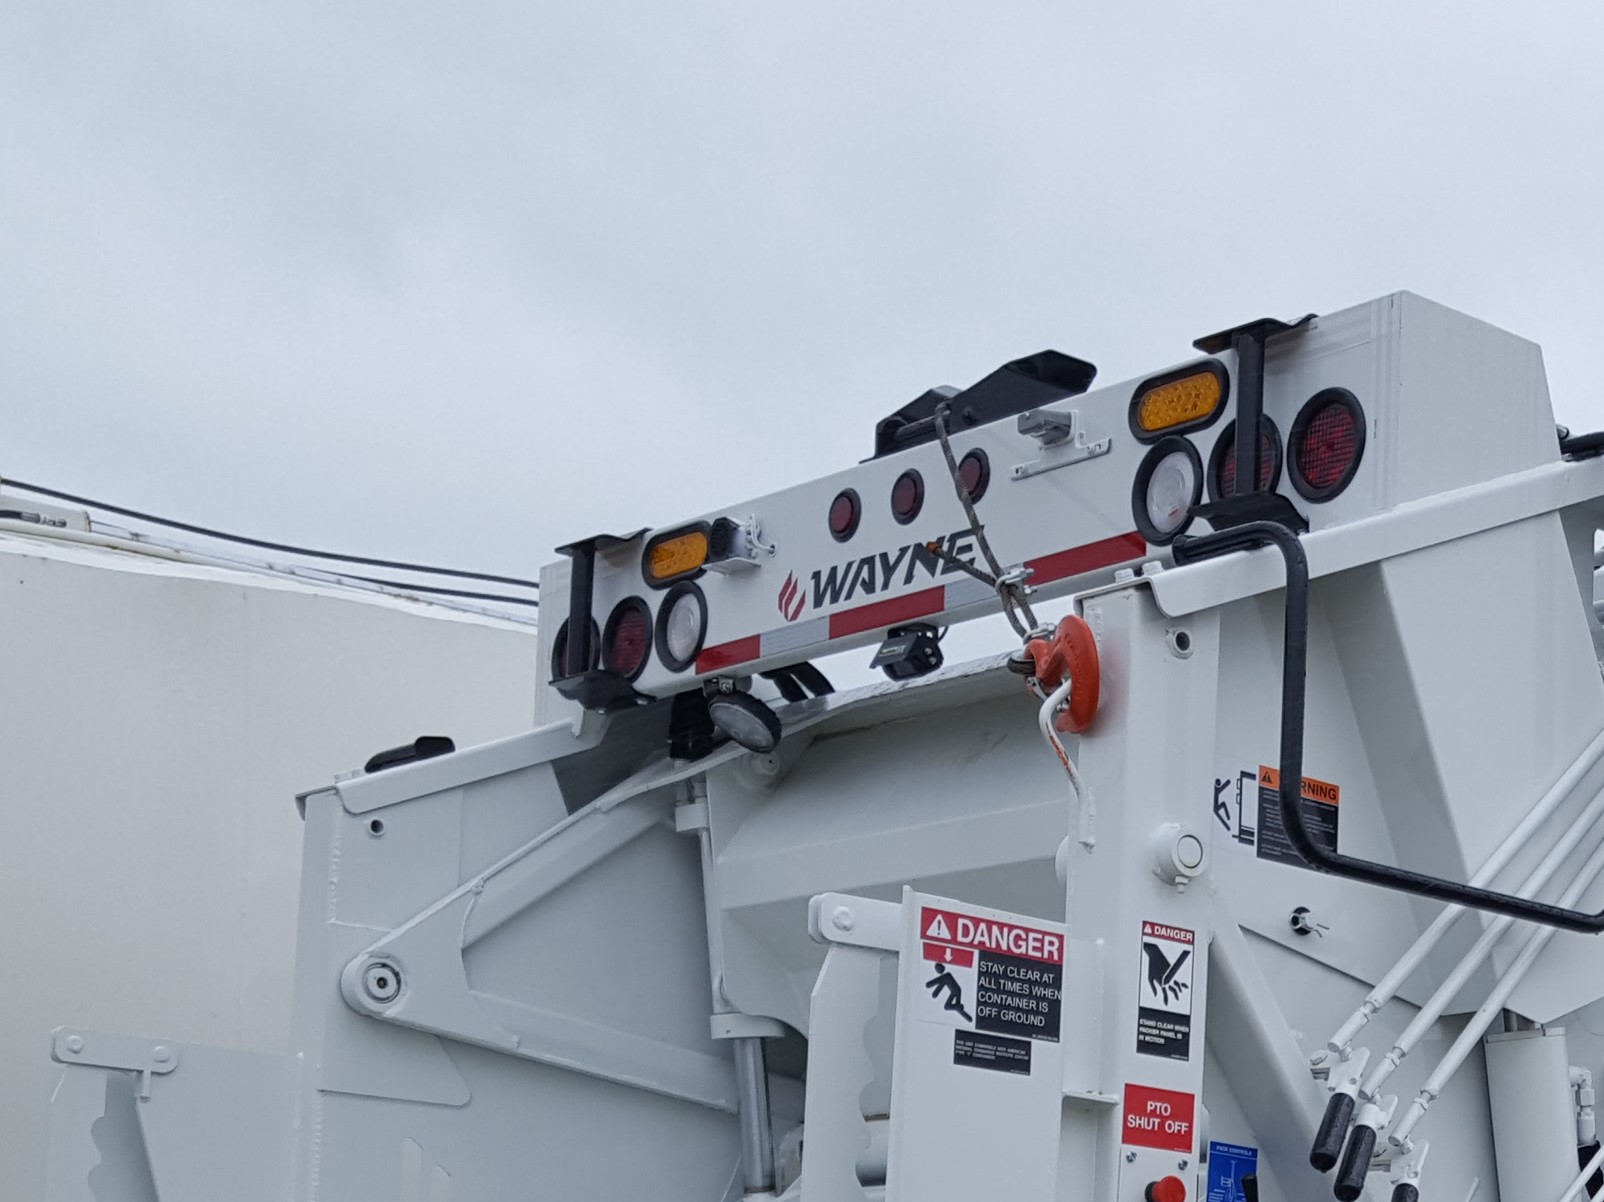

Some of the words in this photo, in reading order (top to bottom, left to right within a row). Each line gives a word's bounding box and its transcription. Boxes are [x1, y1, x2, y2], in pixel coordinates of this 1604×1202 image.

[811, 525, 984, 609] WAYNE
[1301, 780, 1337, 800] RNING
[957, 918, 1059, 960] DANGER
[1154, 925, 1193, 942] DANGER
[980, 961, 1005, 975] STAY
[1007, 966, 1040, 982] CLEAR
[1041, 973, 1054, 984] AT
[979, 976, 997, 989] ALL
[999, 979, 1029, 994] TIMES
[1031, 985, 1062, 1000] WHEN
[978, 991, 1036, 1011] CONTAINER
[1039, 1001, 1049, 1013] IS
[977, 1006, 998, 1018] OFF
[1000, 1010, 1045, 1027] GROUND
[1147, 1101, 1171, 1116] PTO
[1127, 1114, 1161, 1131] SHUT
[1165, 1120, 1189, 1135] OFF
